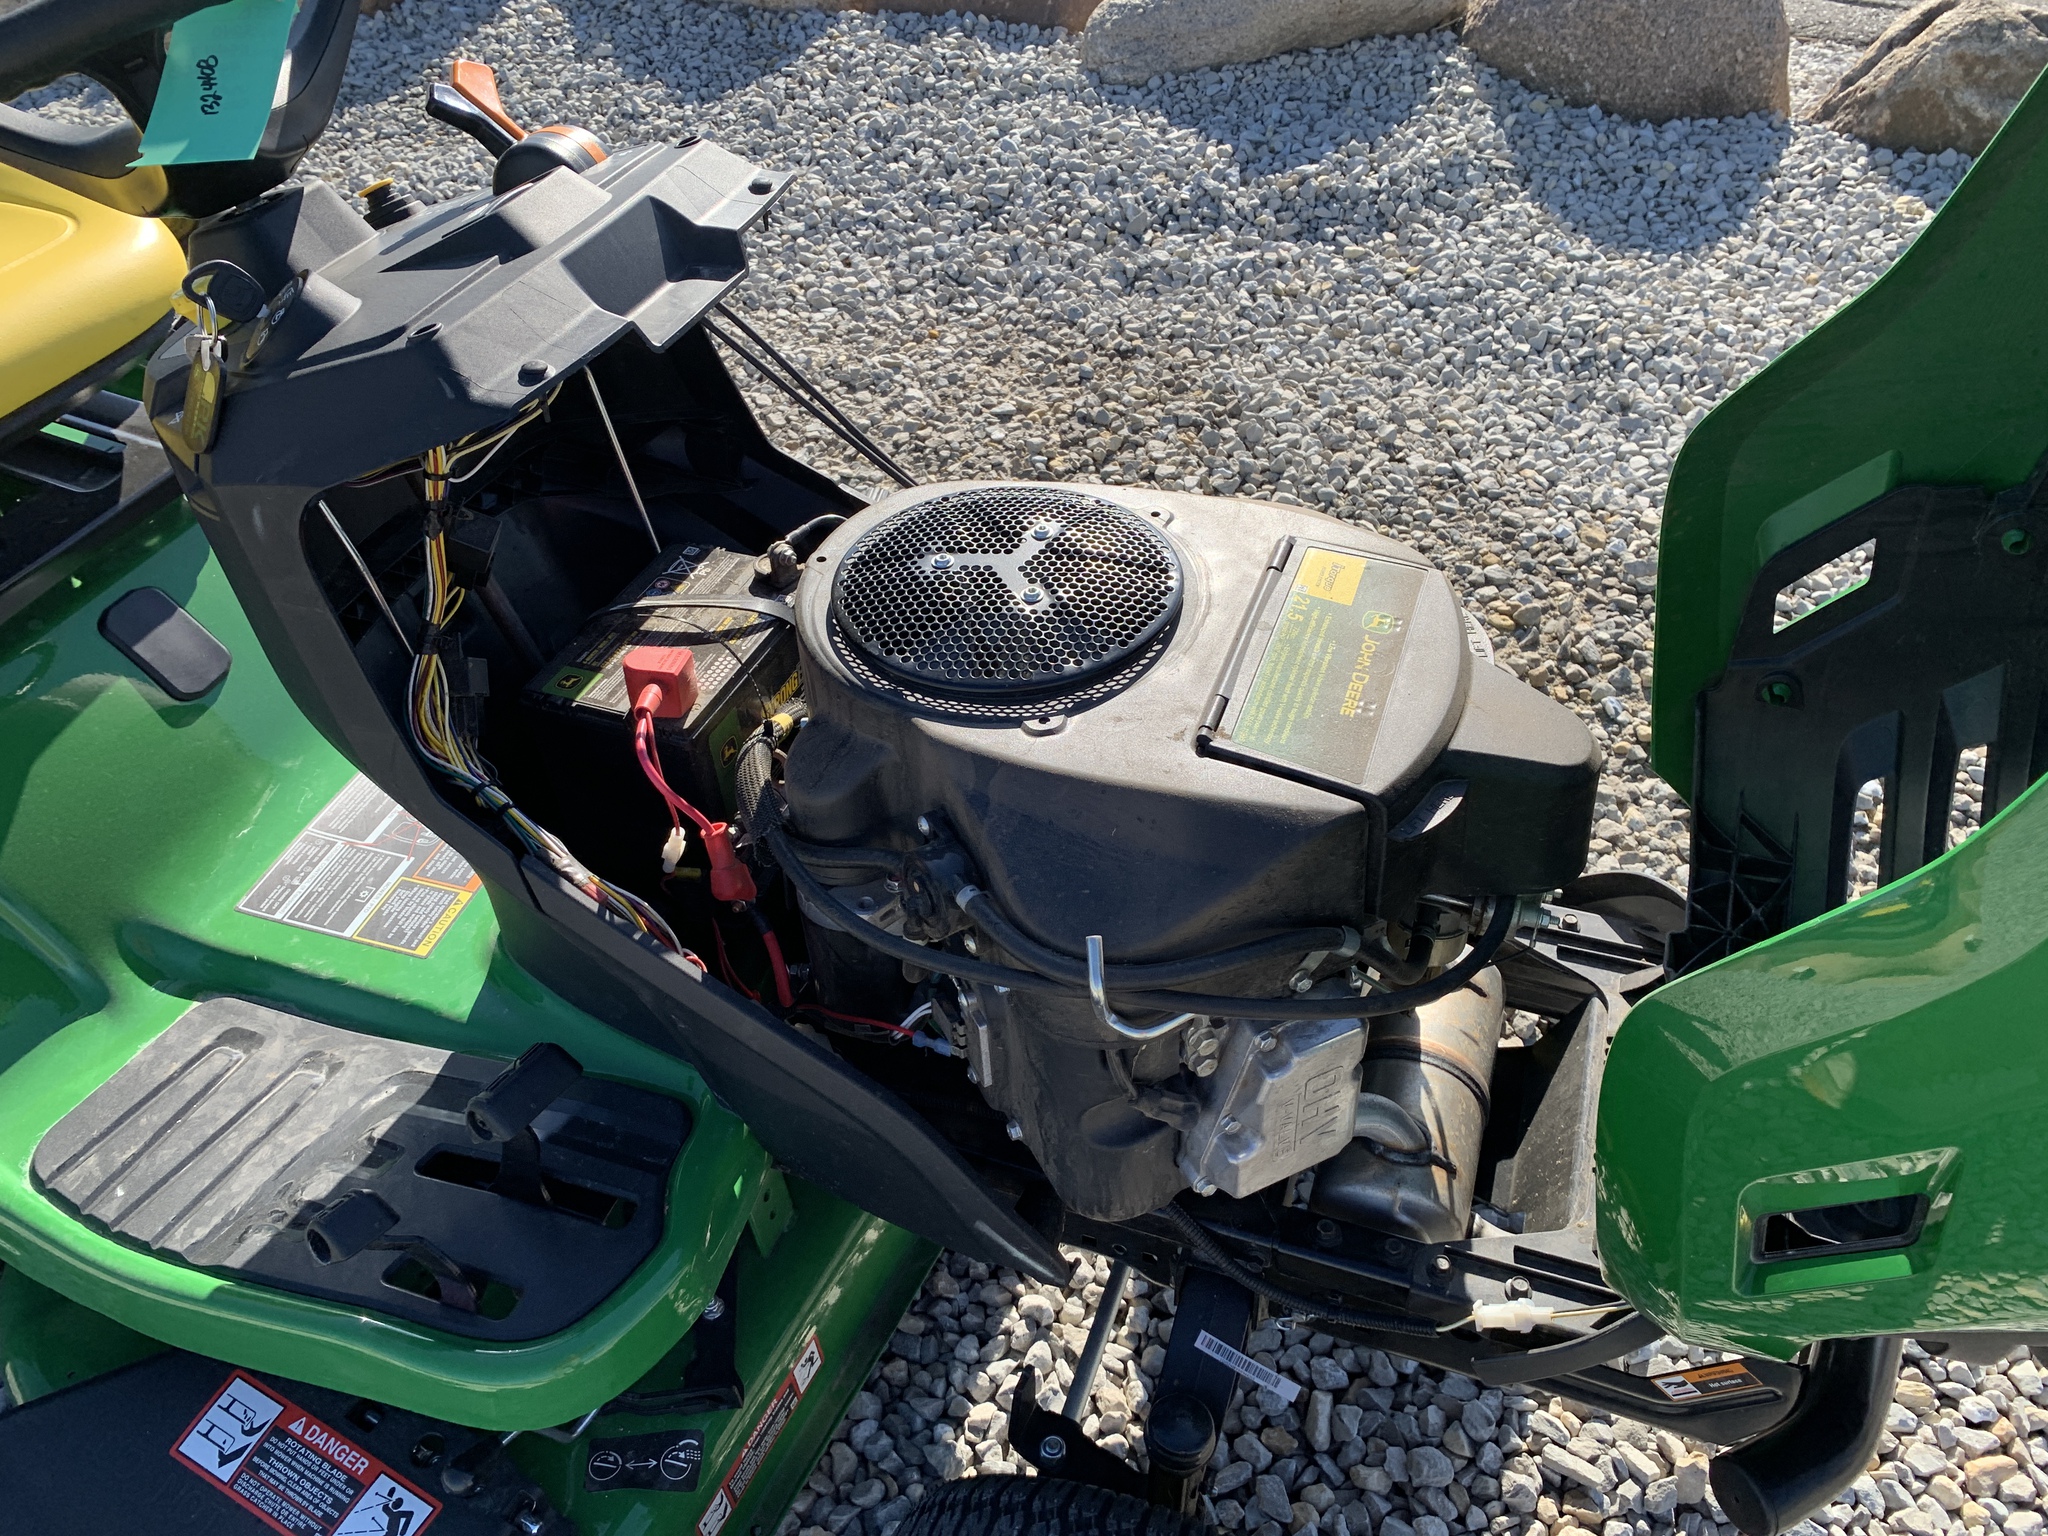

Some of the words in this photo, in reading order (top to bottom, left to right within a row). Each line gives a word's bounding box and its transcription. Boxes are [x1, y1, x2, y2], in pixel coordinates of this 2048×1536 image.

[1286, 595, 1310, 621] 21.5
[1354, 634, 1381, 671] JOHN
[1339, 671, 1369, 718] DEERE
[421, 906, 457, 946] CAUTION
[1299, 1065, 1344, 1145] OHV
[747, 1398, 778, 1447] DANGER
[262, 1441, 275, 1452] INTO
[273, 1448, 291, 1463] MOWER
[290, 1460, 305, 1472] WHEN
[303, 1469, 324, 1486] MACHINE
[328, 1486, 350, 1503] RUNNING
[269, 1436, 278, 1444] DO
[276, 1440, 287, 1450] NOT
[286, 1447, 296, 1456] PUT
[295, 1453, 312, 1467] HANDS
[310, 1463, 319, 1472] OR
[317, 1468, 330, 1479] FEET
[329, 1476, 346, 1490] UNDER
[344, 1487, 354, 1495] OR
[284, 1436, 322, 1465] ROTATING
[321, 1461, 347, 1482] BLADE
[303, 1423, 370, 1476] DANGER
[236, 1478, 264, 1500] DISCHARGE
[263, 1497, 281, 1511] CHUTE
[279, 1508, 289, 1517] OR
[287, 1514, 306, 1529] ENTIRE
[240, 1472, 249, 1480] DO
[248, 1478, 260, 1488] NOT
[259, 1485, 282, 1503] OPERATE
[280, 1500, 300, 1516] MOWER
[298, 1513, 322, 1531] WITHOUT
[251, 1455, 270, 1470] BEFORE
[286, 1479, 302, 1492] CLEAR
[300, 1489, 313, 1500] AREA
[311, 1497, 320, 1505] OF
[318, 1501, 339, 1518] OBJECTS
[257, 1469, 270, 1480] THAT
[268, 1477, 279, 1487] MAY
[277, 1483, 285, 1491] BE
[283, 1488, 303, 1503] THROWN
[307, 1504, 323, 1517] BLADE
[267, 1456, 299, 1481] THROWN
[298, 1477, 333, 1504] OBJECTS
[232, 1483, 250, 1498] GRASS
[249, 1495, 272, 1513] CATCHER
[271, 1510, 278, 1518] IN
[278, 1515, 294, 1529] PLACE
